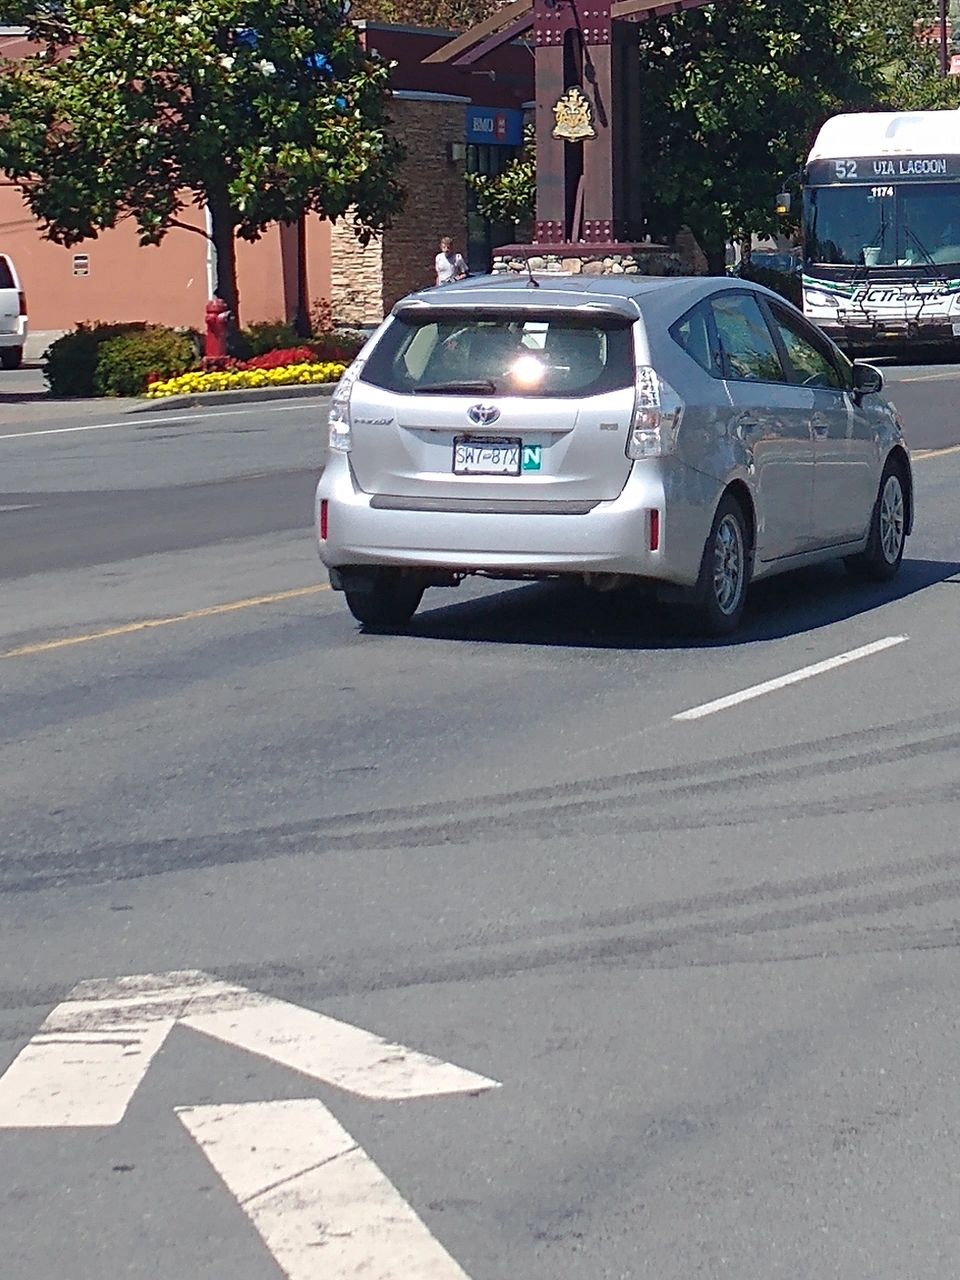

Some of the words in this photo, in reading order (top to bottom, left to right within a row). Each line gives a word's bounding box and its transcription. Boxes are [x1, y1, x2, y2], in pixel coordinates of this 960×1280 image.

[473, 117, 494, 132] BMO
[836, 160, 857, 178] 52
[873, 161, 895, 175] VIA
[900, 160, 946, 174] LAGOON
[871, 186, 893, 197] 1174
[524, 447, 541, 464] N
